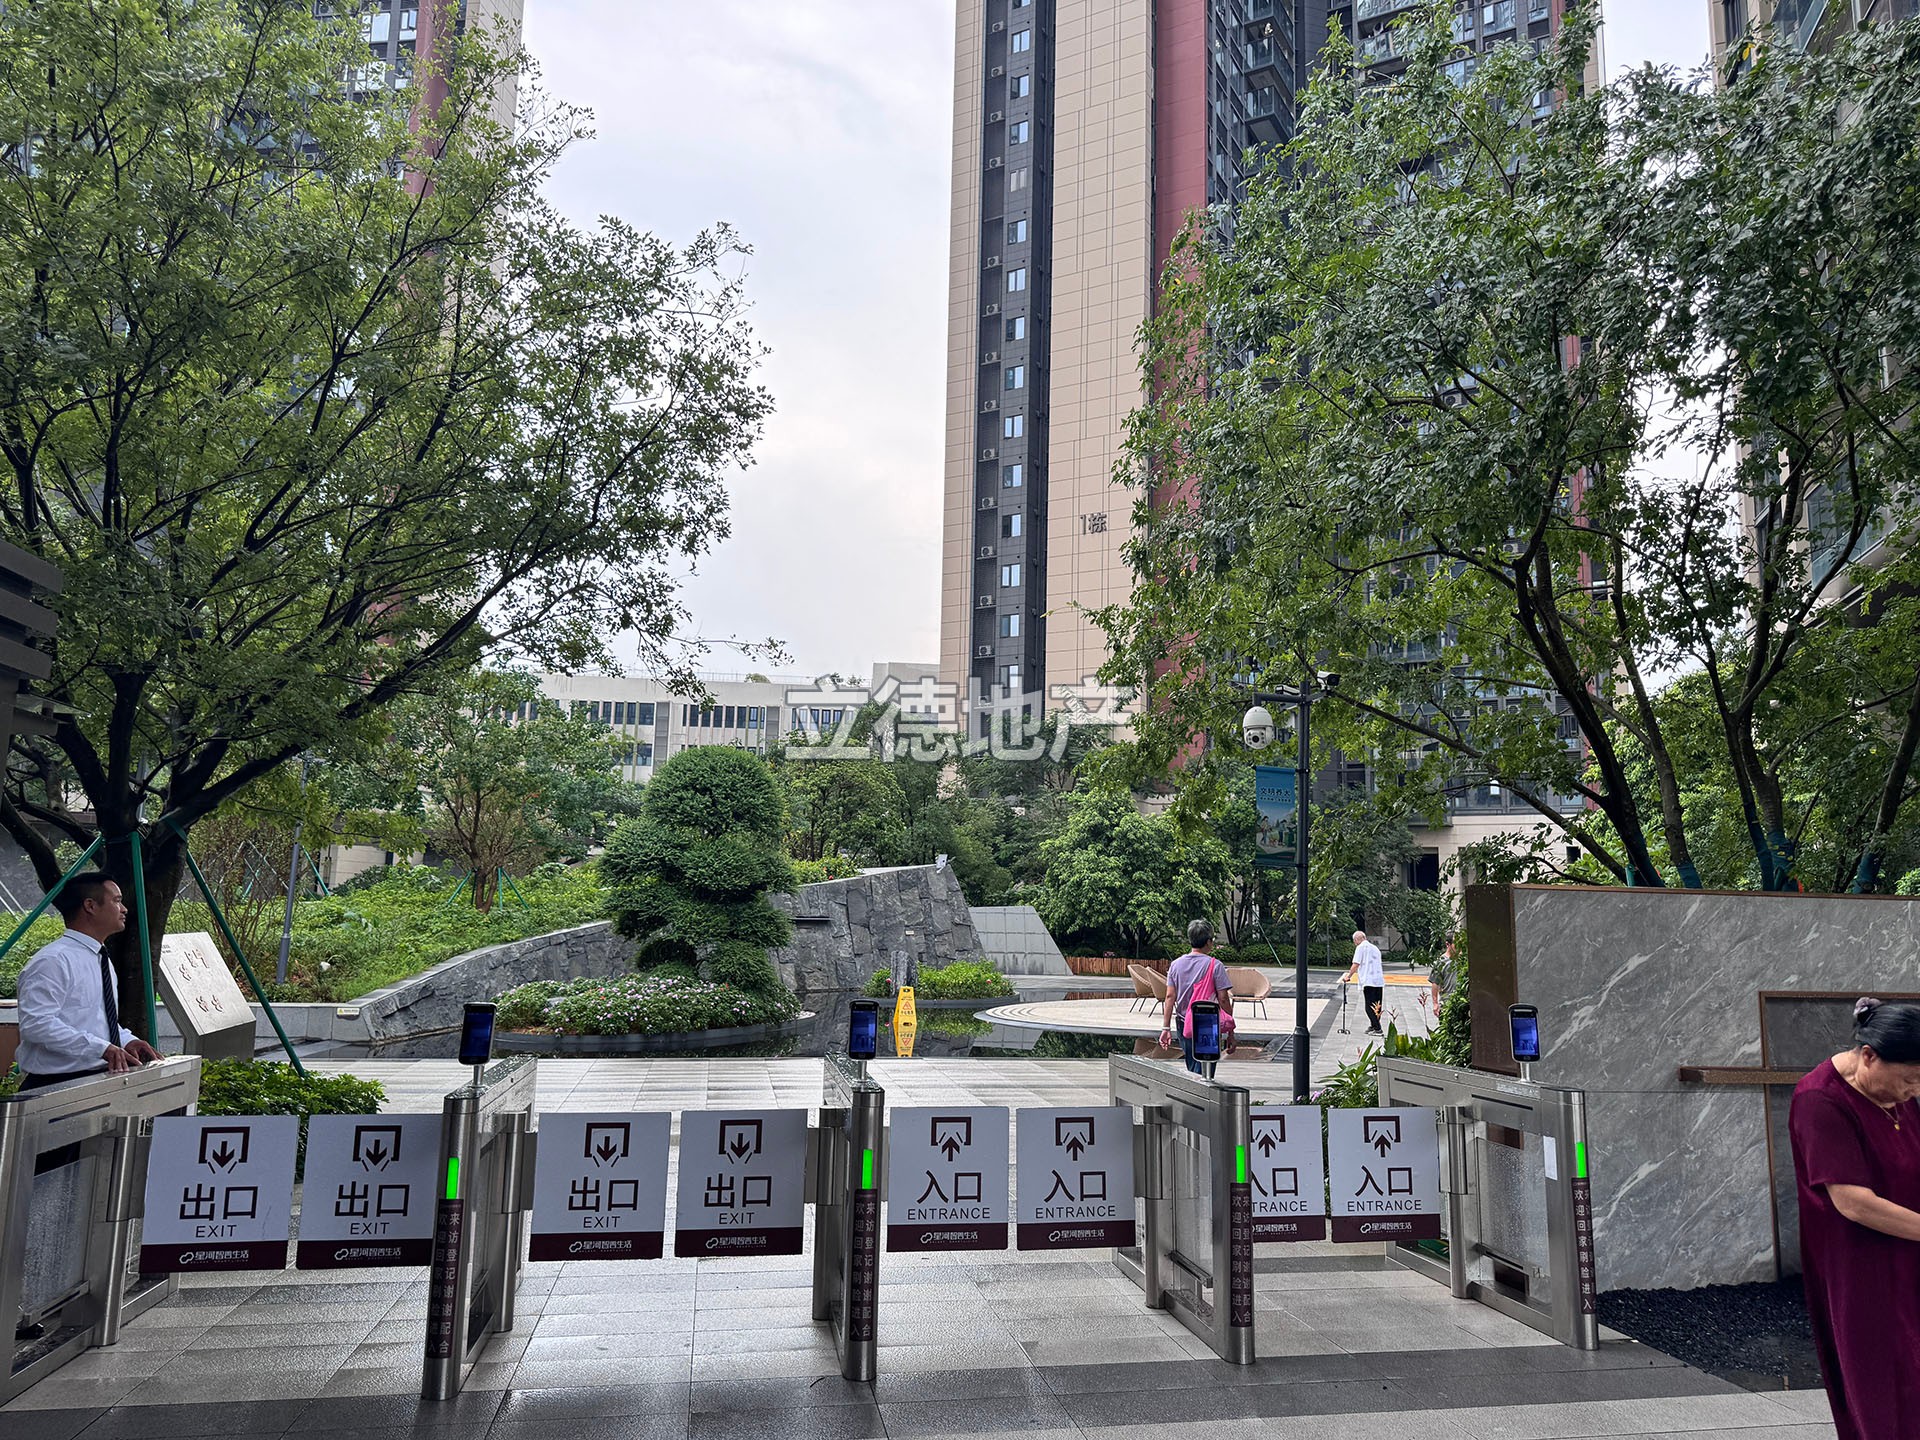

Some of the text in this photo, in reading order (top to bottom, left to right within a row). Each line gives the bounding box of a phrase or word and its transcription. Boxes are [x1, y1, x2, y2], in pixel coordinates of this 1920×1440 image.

[568, 1176, 639, 1212] 出口
[704, 1173, 772, 1209] 出口
[916, 1169, 982, 1204] 入口
[1043, 1167, 1107, 1202] 入口
[1354, 1165, 1413, 1196] 入口
[180, 1183, 258, 1221] 出口
[334, 1181, 409, 1219] 出口
[907, 1207, 991, 1220] ENTRANCE
[1035, 1205, 1116, 1219] ENTRANCE
[1252, 1200, 1308, 1213] TRANCE
[1347, 1199, 1422, 1212] ENTRANCE
[195, 1225, 238, 1238] EXIT
[350, 1222, 390, 1235] EXIT
[583, 1215, 621, 1228] EXIT
[718, 1211, 755, 1224] EXIT
[438, 1212, 461, 1354] 来访登记谢谢配合
[862, 1202, 876, 1337] 来访登记谢谢配合
